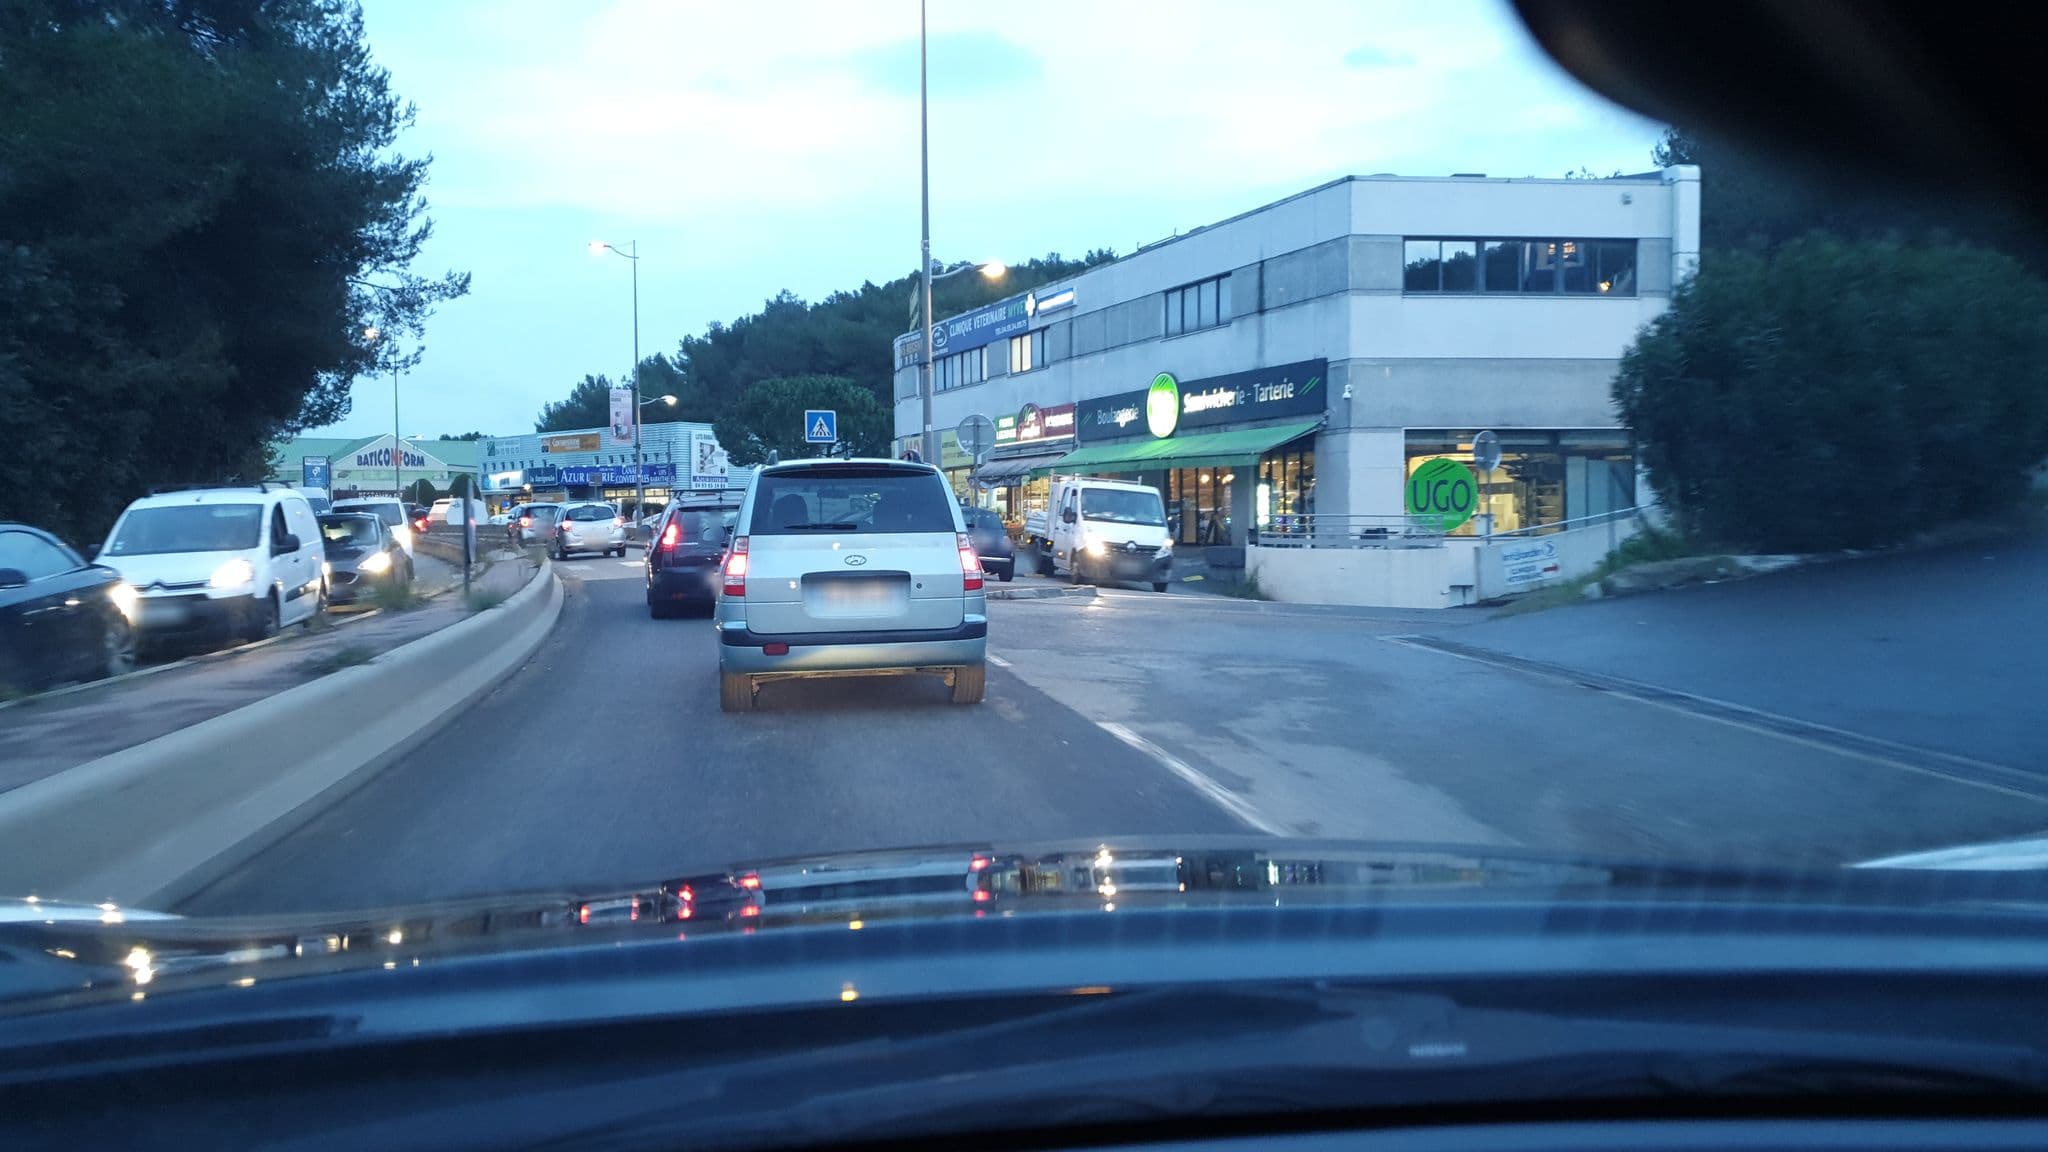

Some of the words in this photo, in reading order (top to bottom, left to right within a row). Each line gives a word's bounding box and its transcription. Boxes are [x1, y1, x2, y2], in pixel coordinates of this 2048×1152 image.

[949, 318, 973, 336] CLINIQUE
[973, 307, 1007, 328] VETERINAIRE
[1183, 384, 1245, 413] Sandwicherie
[1253, 378, 1294, 403] Tarterie
[1097, 403, 1139, 428] Boulangerie
[356, 448, 425, 466] BATICONFORM
[561, 465, 584, 483] AZUR
[586, 470, 616, 482] LRIE
[1412, 479, 1471, 513] UGO
